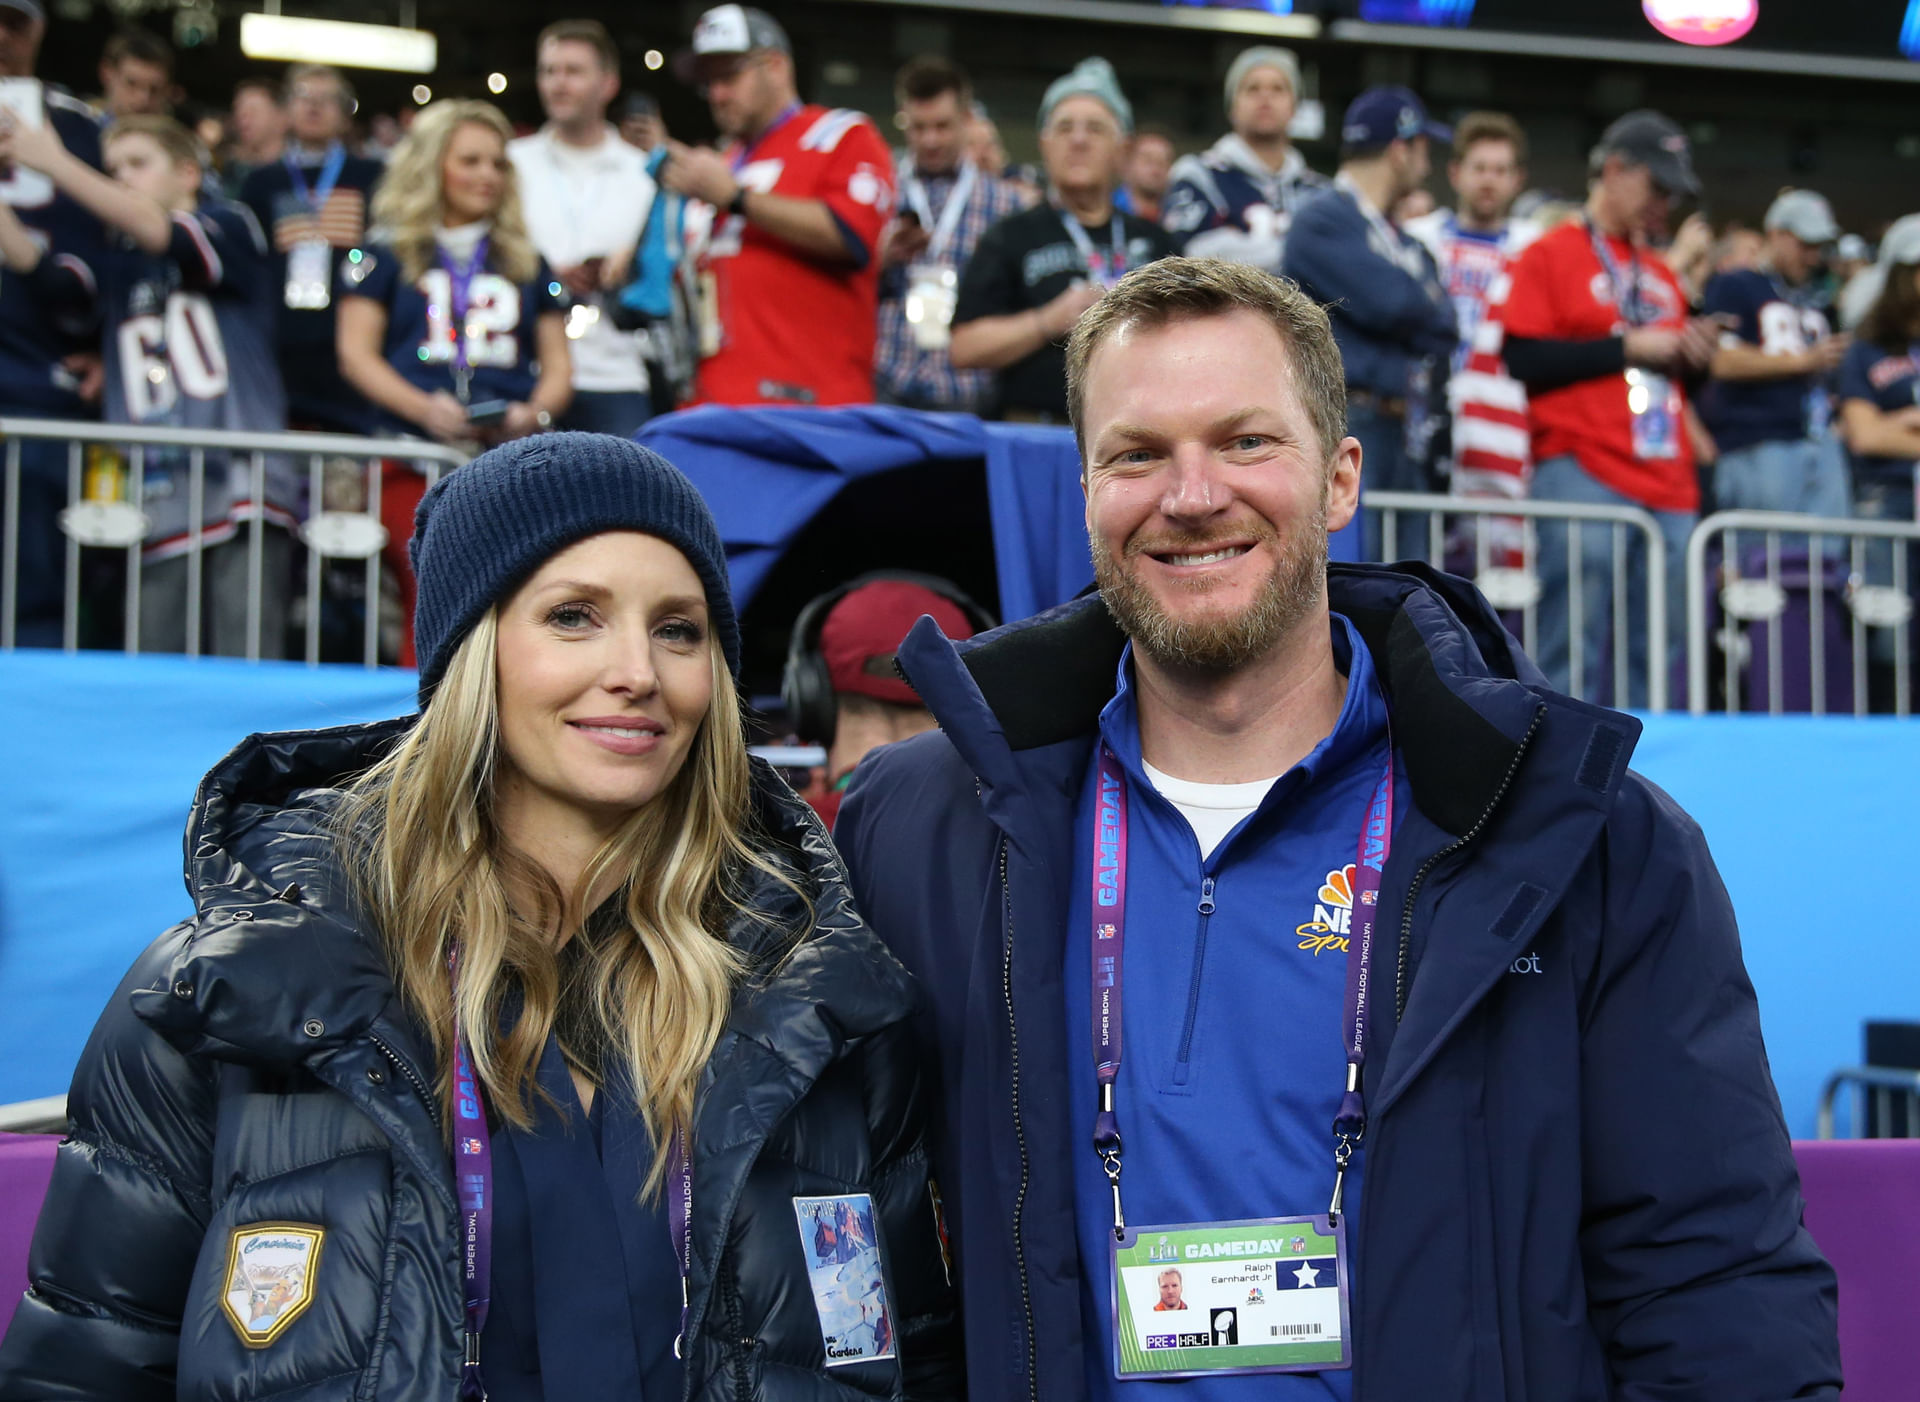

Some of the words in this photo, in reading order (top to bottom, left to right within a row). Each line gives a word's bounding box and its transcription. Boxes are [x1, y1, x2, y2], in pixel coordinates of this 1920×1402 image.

[416, 268, 520, 368] 12
[117, 291, 229, 421] 60
[1363, 765, 1389, 872] MEDAY
[1098, 771, 1120, 906] GAMEDAY
[1312, 904, 1352, 934] NB
[1361, 922, 1371, 966] NATIONAL
[1098, 956, 1115, 987] LII
[1357, 968, 1368, 1015] FOOTBALL
[1354, 1017, 1364, 1052] LEAGUE
[463, 1174, 484, 1209] LII
[683, 1175, 692, 1227] FOOTBALL
[468, 1211, 477, 1242] BOWL
[467, 1243, 476, 1279] SUPER
[684, 1229, 692, 1270] LEAGUE
[1185, 1238, 1284, 1258] GAMEDAY
[1211, 1274, 1260, 1284] Earnhardt
[1244, 1263, 1272, 1272] Ralph
[1179, 1333, 1209, 1346] HALF
